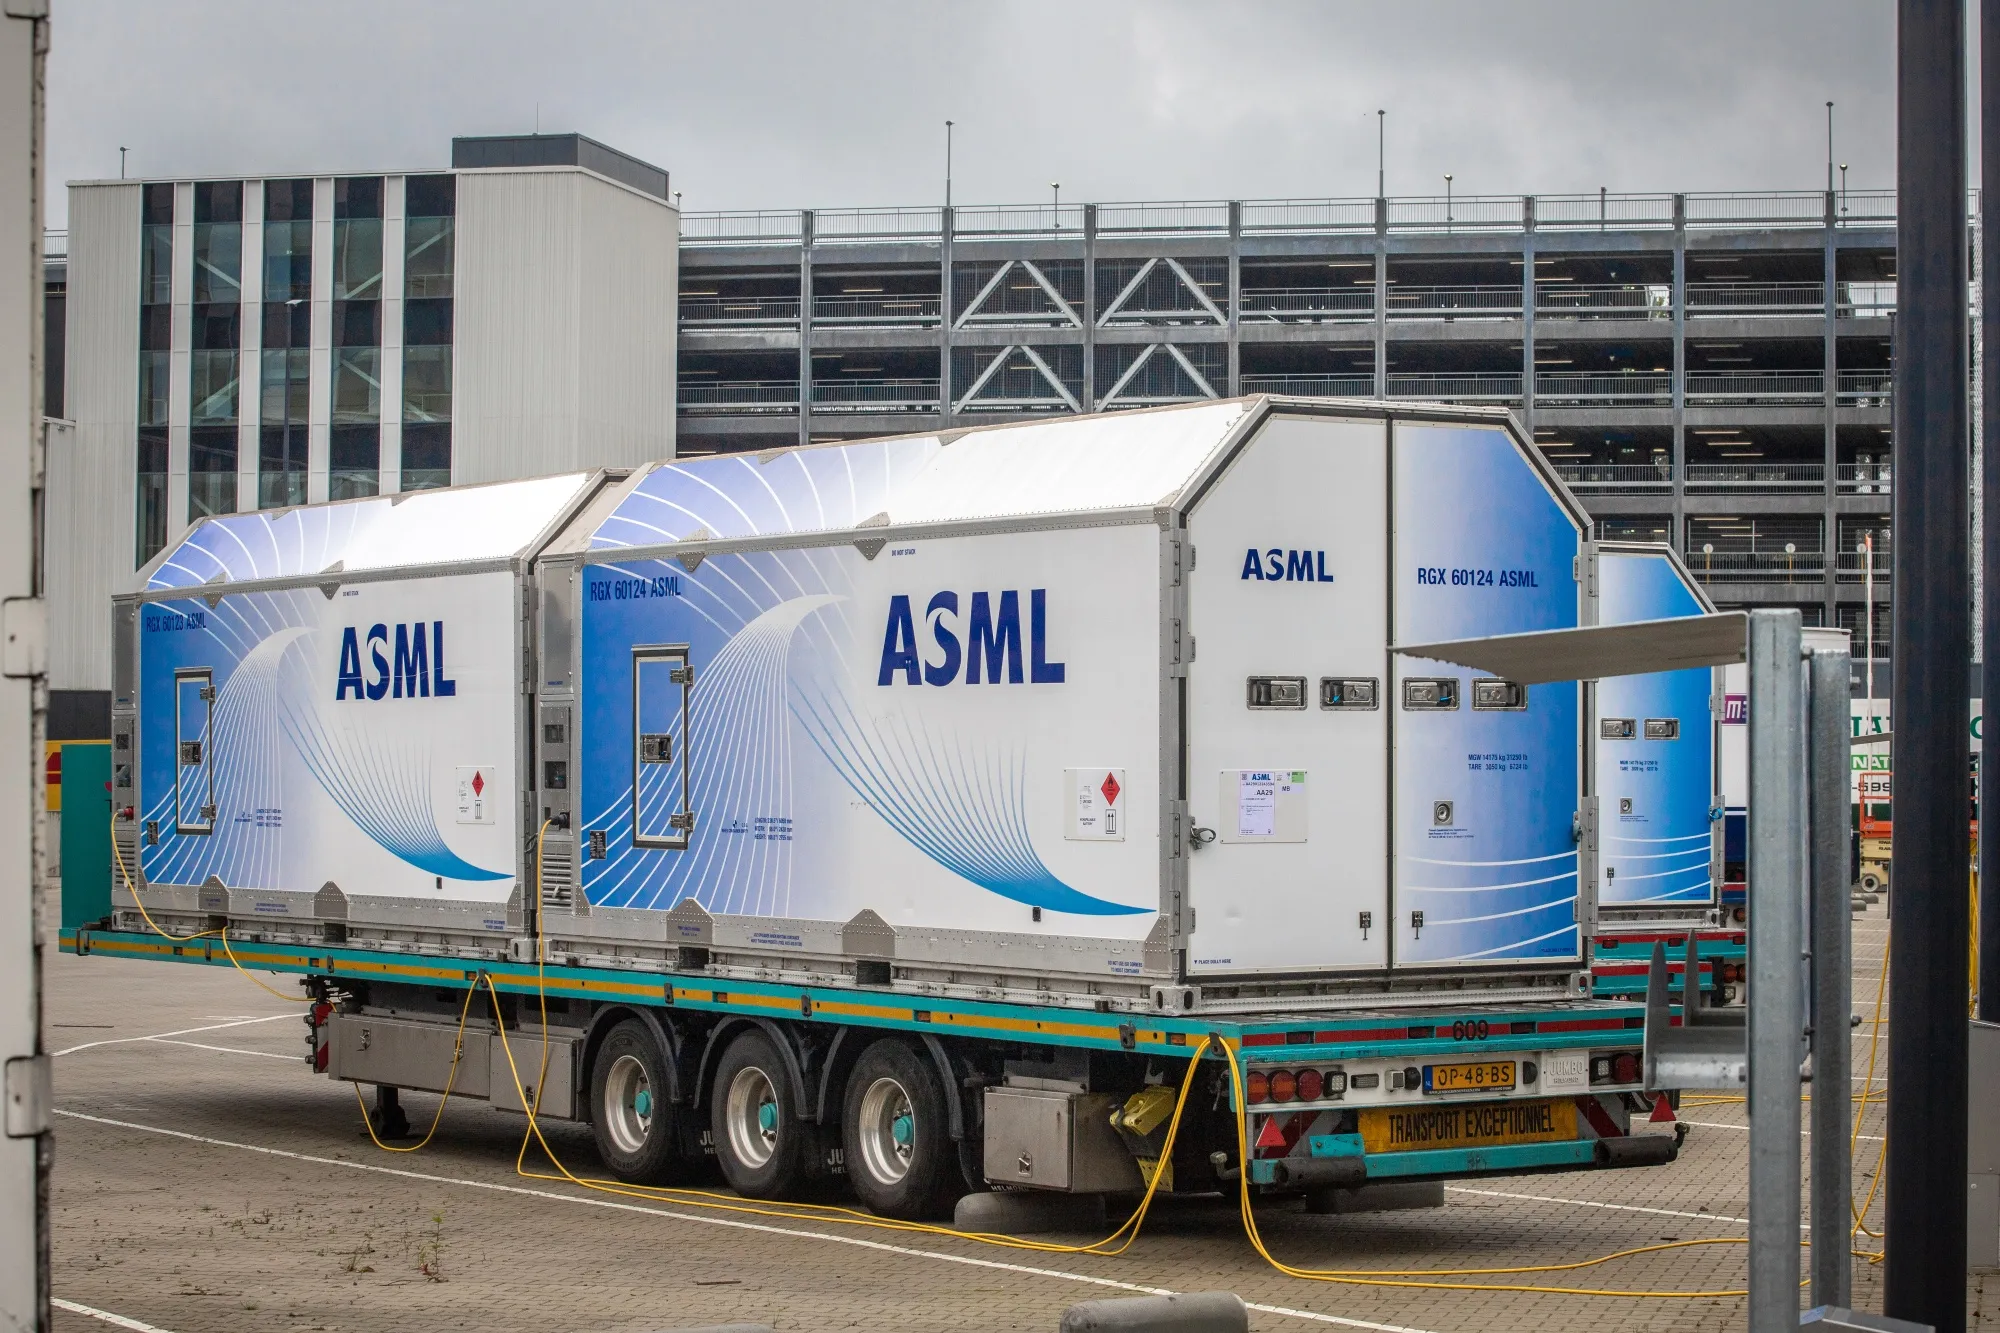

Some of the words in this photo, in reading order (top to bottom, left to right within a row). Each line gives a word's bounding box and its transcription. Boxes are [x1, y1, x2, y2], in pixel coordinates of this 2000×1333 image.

[1240, 548, 1334, 582] ASML
[1417, 567, 1447, 585] RGX
[1451, 568, 1494, 587] 60124
[1499, 570, 1539, 588] ASML
[590, 581, 612, 602] RGX
[614, 578, 647, 600] 60124
[650, 576, 681, 598] ASML
[146, 616, 161, 633] RGX
[162, 614, 184, 632] 60123
[186, 611, 206, 630] ASML
[877, 588, 1066, 688] ASML
[335, 620, 456, 701] ASML
[1467, 763, 1482, 771] TARE
[1498, 763, 1506, 772] kg
[1468, 753, 1482, 761] MGW
[1498, 754, 1506, 762] kg
[1522, 753, 1528, 761] lb
[1251, 773, 1271, 781] ASML
[1453, 1020, 1488, 1041] 609
[1438, 1065, 1511, 1086] OP-48-BS
[1550, 1060, 1584, 1075] JUMBO
[1388, 1110, 1461, 1144] TRANSPORT
[1465, 1103, 1556, 1138] EXCEPTIONNEL
